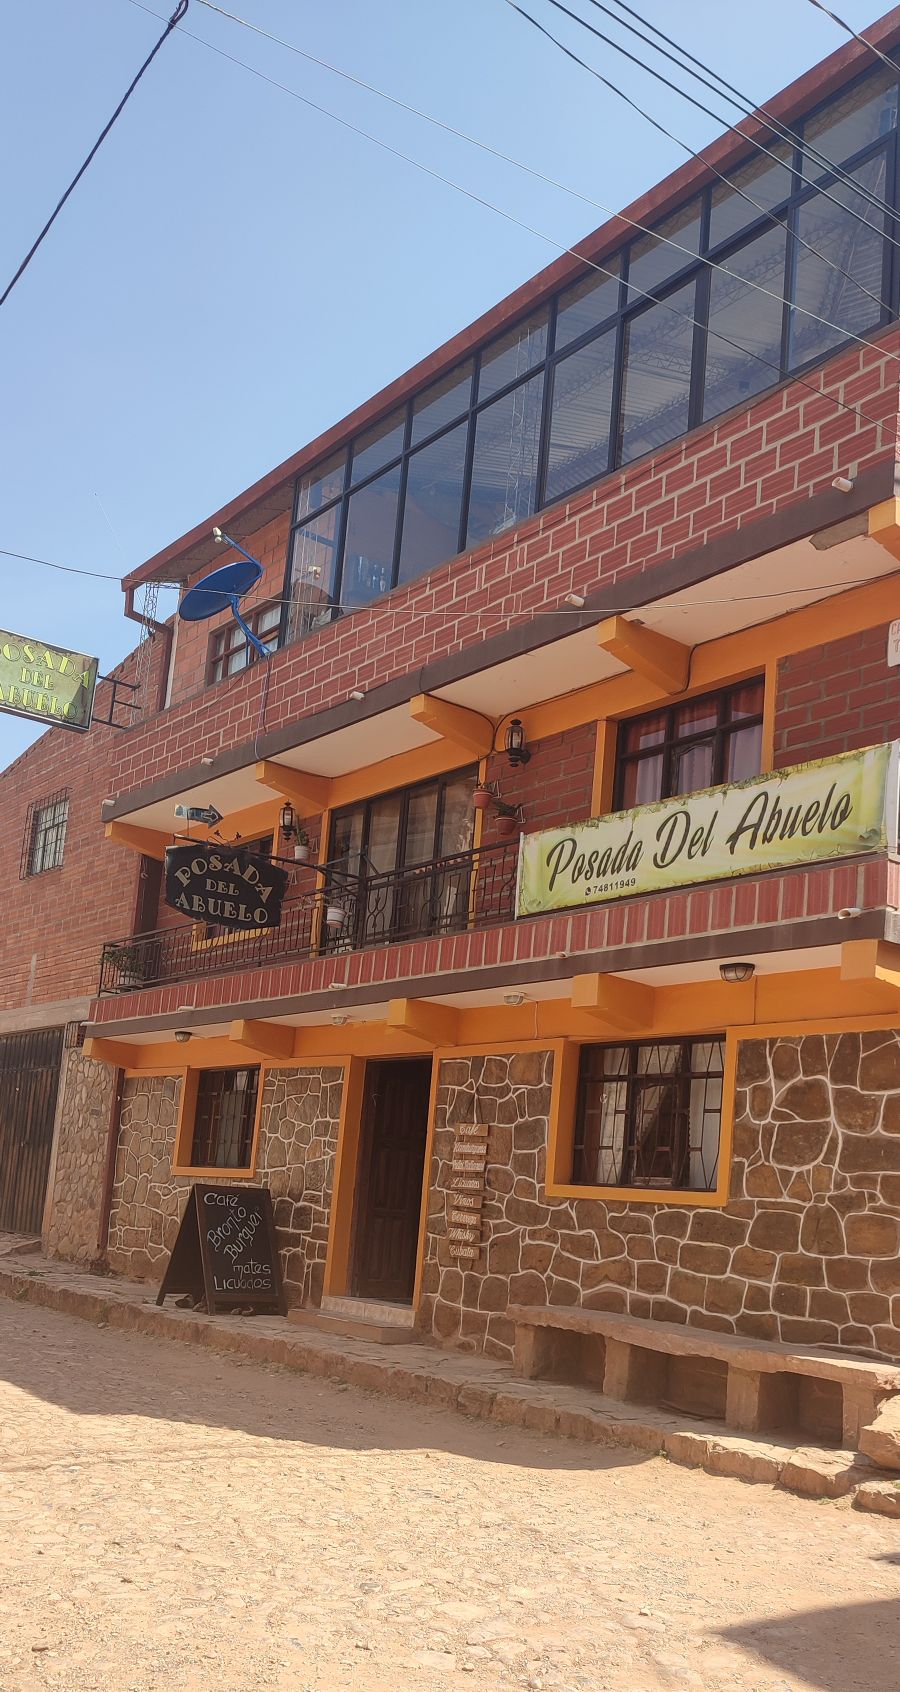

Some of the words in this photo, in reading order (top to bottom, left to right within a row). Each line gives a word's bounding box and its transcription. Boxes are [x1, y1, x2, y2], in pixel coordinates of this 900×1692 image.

[0, 643, 90, 690] OSADA
[19, 666, 54, 690] DEL
[546, 829, 645, 892] Posada
[652, 810, 719, 869] Del
[725, 782, 853, 856] Abuelo
[174, 854, 273, 904] POSADA
[205, 878, 240, 896] DEL
[593, 877, 636, 894] 74811949
[175, 891, 268, 924] ABUELO
[203, 1192, 239, 1207] Café
[207, 1206, 247, 1253] Bronto
[232, 1258, 272, 1280] mates
